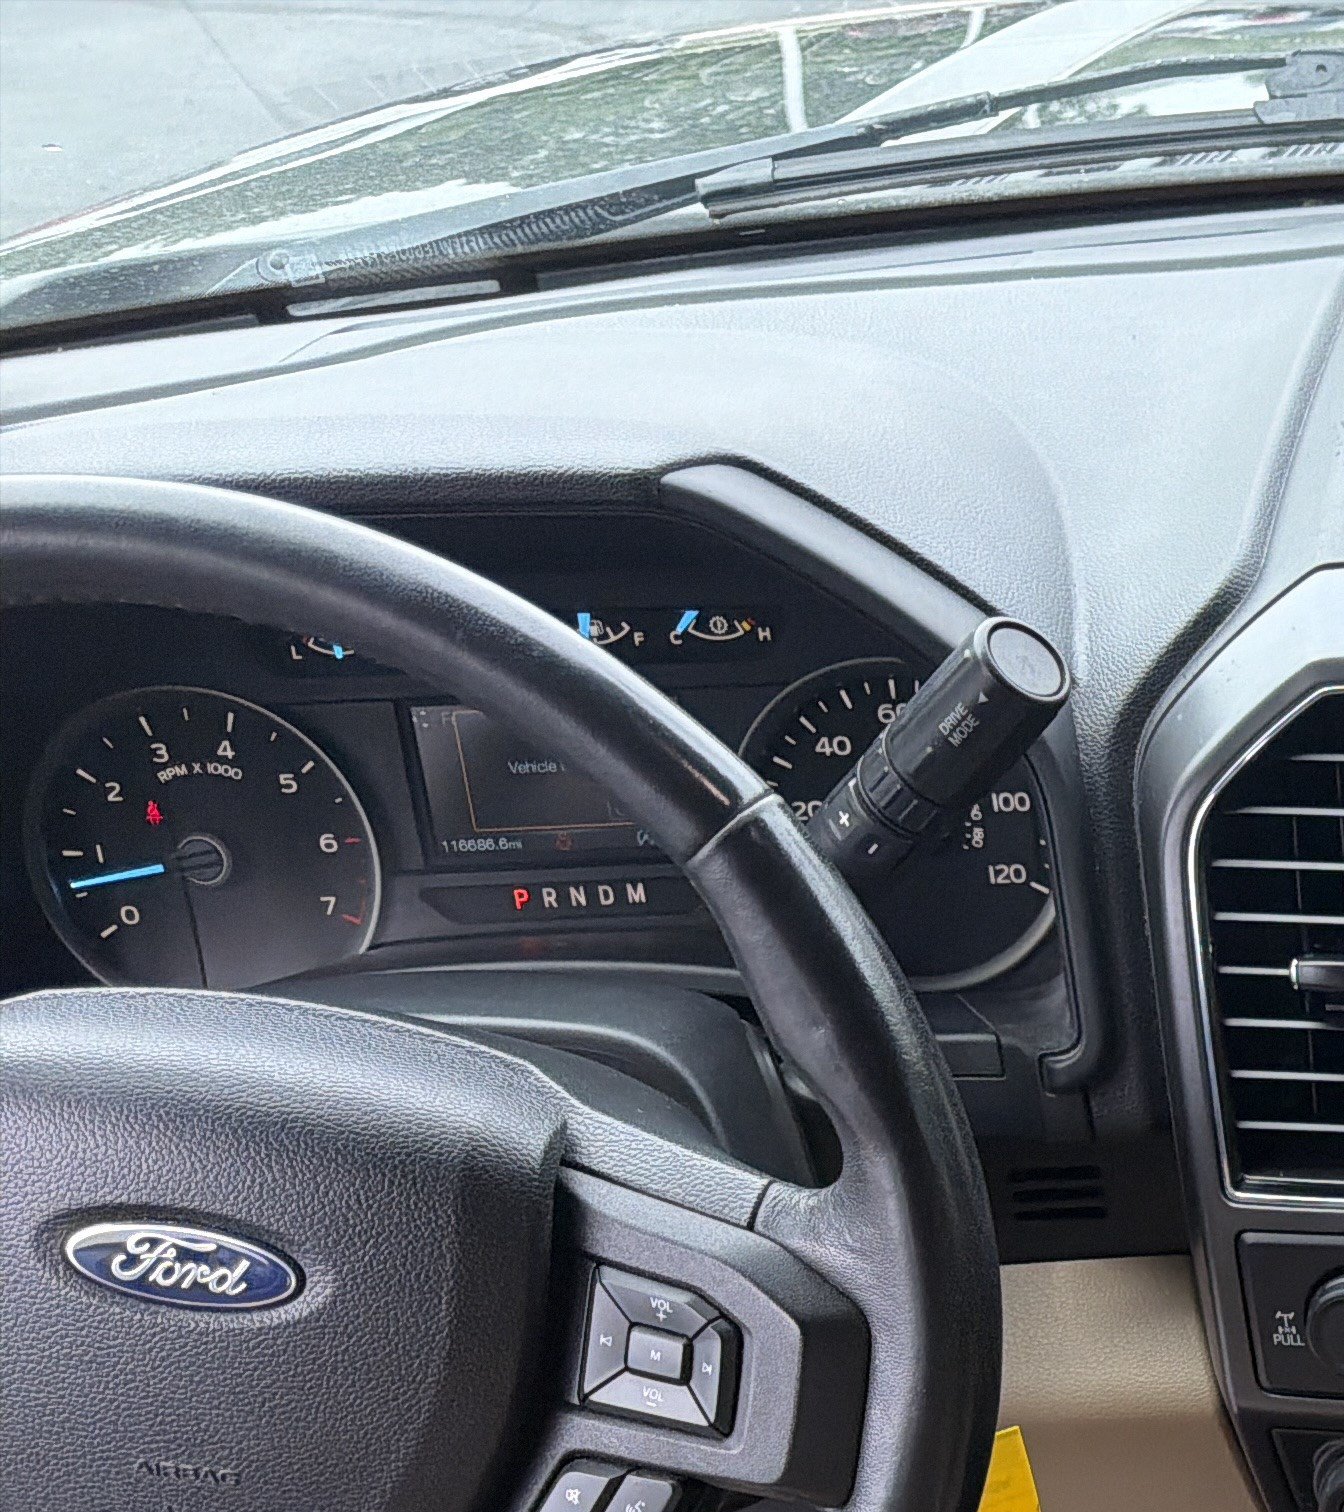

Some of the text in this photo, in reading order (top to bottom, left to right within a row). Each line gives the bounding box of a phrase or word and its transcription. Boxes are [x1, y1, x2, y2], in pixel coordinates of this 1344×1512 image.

[633, 631, 645, 646] F
[669, 630, 683, 645] C
[757, 627, 772, 642] H
[290, 645, 303, 660] L
[938, 701, 969, 736] DRIVE
[947, 713, 980, 747] MODE
[150, 742, 170, 763] 3
[216, 740, 236, 760] 4
[814, 735, 852, 757] 40
[157, 762, 243, 784] RPM X 1000
[507, 760, 558, 775] Vehicle
[104, 782, 124, 802] 2
[279, 773, 298, 793] 5
[991, 792, 1031, 813] 100
[319, 833, 339, 853] 6
[988, 864, 1028, 885] 120
[319, 896, 337, 916] 7
[513, 882, 648, 910] P R N D M
[120, 905, 141, 926] 0
[111, 1231, 251, 1297] Ford
[649, 1296, 673, 1314] VOL
[1272, 1333, 1306, 1347] PULL
[650, 1349, 662, 1362] M
[642, 1385, 664, 1402] VOL
